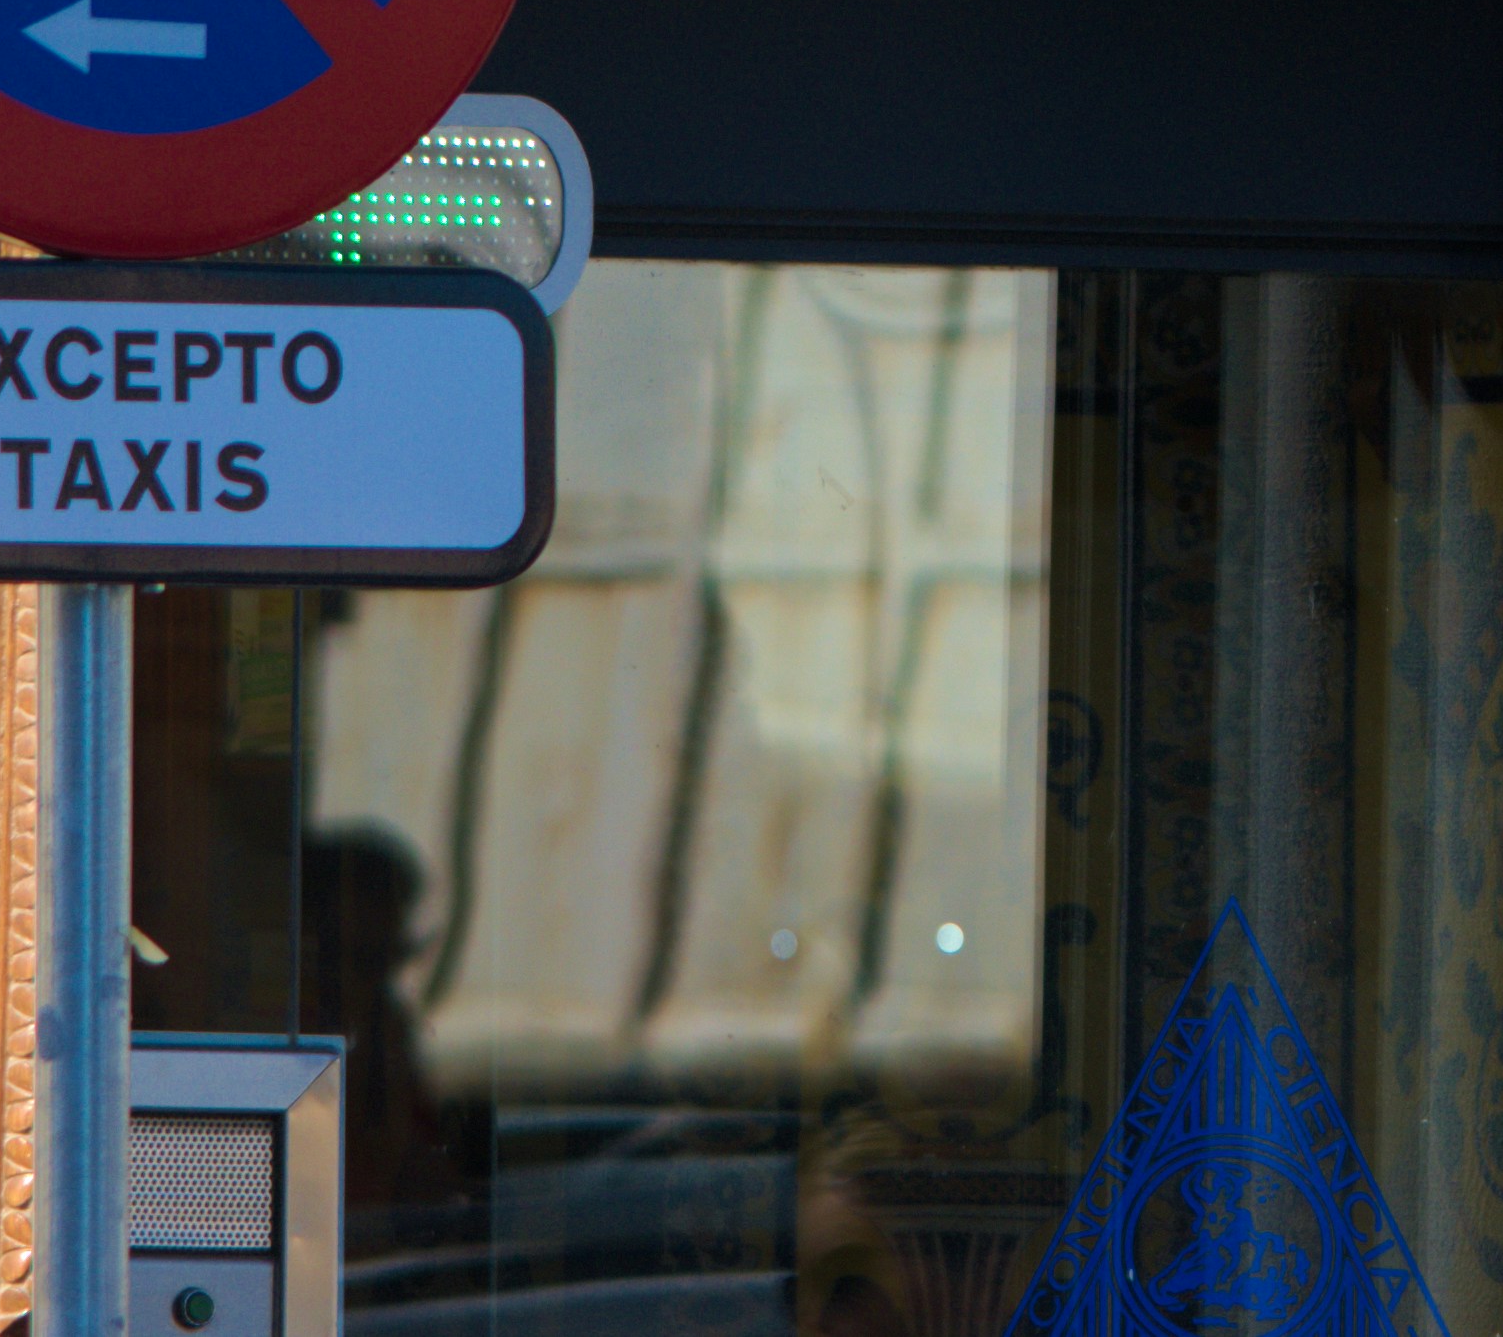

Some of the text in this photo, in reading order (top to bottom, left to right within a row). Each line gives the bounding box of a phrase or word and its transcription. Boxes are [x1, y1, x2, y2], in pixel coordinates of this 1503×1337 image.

[0, 437, 270, 513] TAXIS
[1027, 1015, 1210, 1331] CONCIENCIA
[1264, 1024, 1414, 1316] CIENCIA
